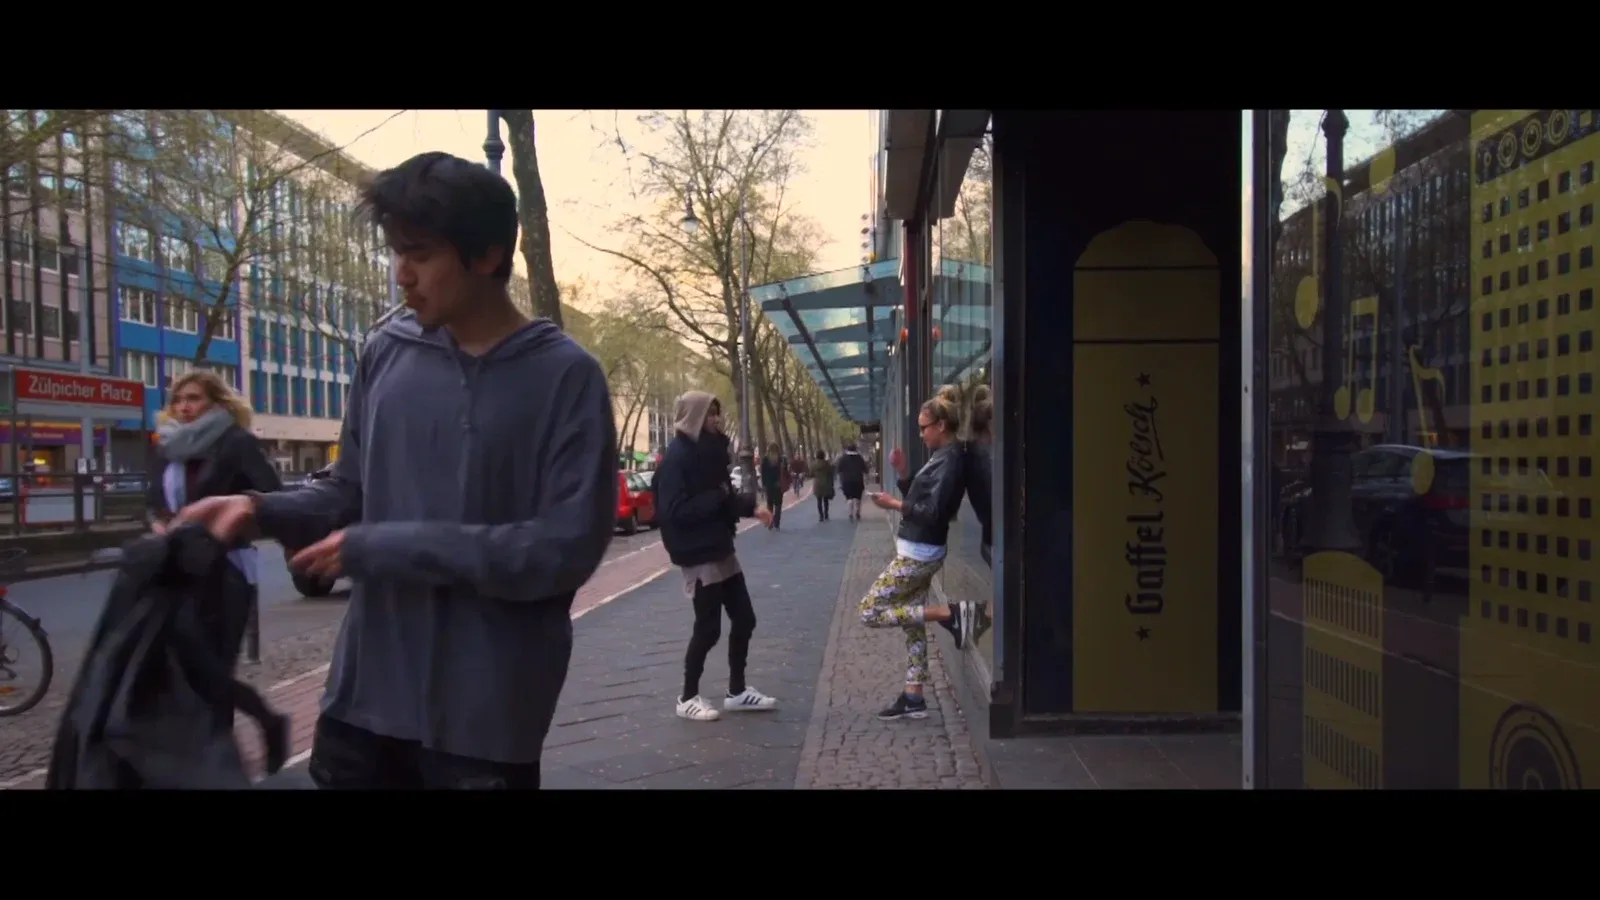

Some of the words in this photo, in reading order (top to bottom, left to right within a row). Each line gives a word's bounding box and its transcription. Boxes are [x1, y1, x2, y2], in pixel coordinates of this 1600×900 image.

[28, 375, 96, 399] Zülpicher
[100, 383, 133, 401] Platz
[1123, 395, 1167, 504] Kölsch
[1125, 510, 1167, 615] Gaffel
